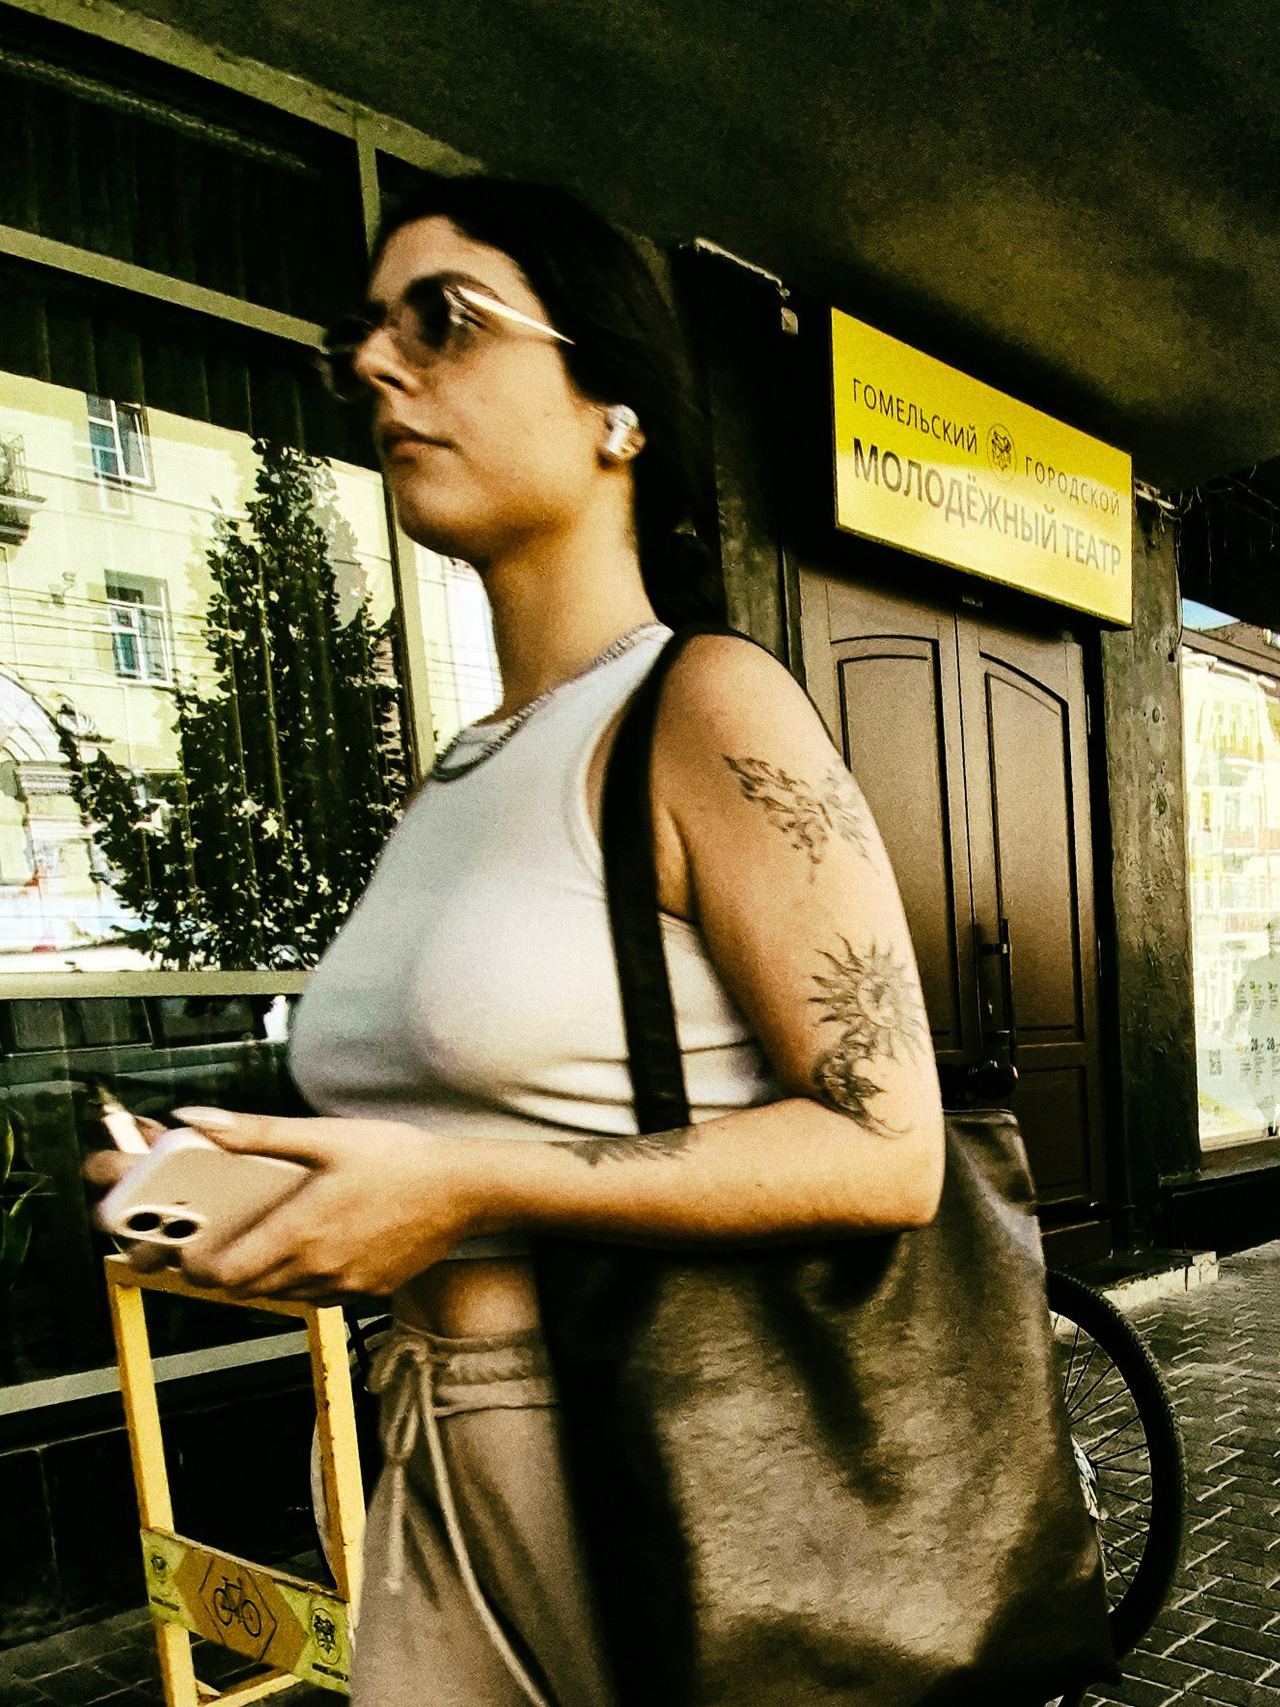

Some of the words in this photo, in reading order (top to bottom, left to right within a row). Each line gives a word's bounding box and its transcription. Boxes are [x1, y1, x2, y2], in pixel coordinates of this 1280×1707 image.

[853, 377, 978, 455] ГОМЕЛЬСКИЙ
[1025, 456, 1120, 518] ГОРОДСКОЙ
[853, 437, 1057, 554] МОЛОДЁЖНЫЙ
[1062, 524, 1121, 576] ТЕАТР
